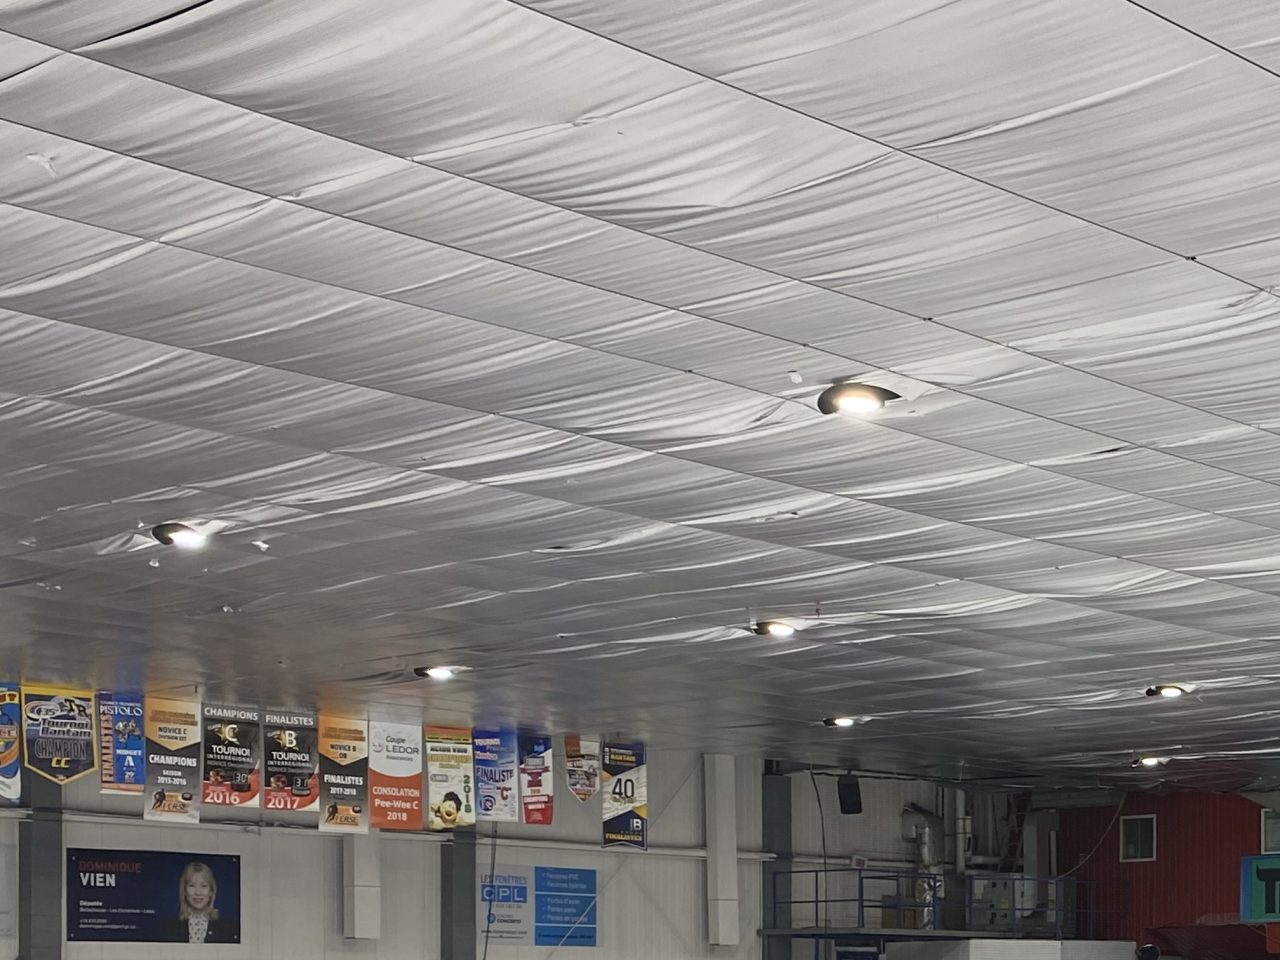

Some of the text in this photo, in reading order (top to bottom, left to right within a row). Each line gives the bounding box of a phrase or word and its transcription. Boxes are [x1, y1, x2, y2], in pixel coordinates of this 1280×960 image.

[204, 707, 258, 721] CHAMPIONS
[265, 714, 314, 726] FINALISTES
[41, 718, 88, 728] Tournoi
[41, 727, 91, 737] Bantam
[225, 725, 238, 742] C
[285, 730, 297, 748] B
[386, 735, 406, 744] Coupe
[35, 739, 86, 760] CHAMPION
[211, 745, 250, 757] TOURNOI
[149, 754, 197, 767] CHAMPIONS
[272, 751, 310, 762] TOURNOI
[324, 774, 363, 785] FINALISTES
[373, 786, 420, 797] CONSOLATION
[612, 778, 635, 798] 40
[205, 790, 240, 804] 2016
[267, 796, 300, 809] 2017
[374, 798, 419, 809] Pee-Wee C
[387, 812, 408, 821] 2018
[634, 819, 642, 831] B
[79, 861, 142, 873] DOMINIQUE
[80, 873, 116, 887] VIEN
